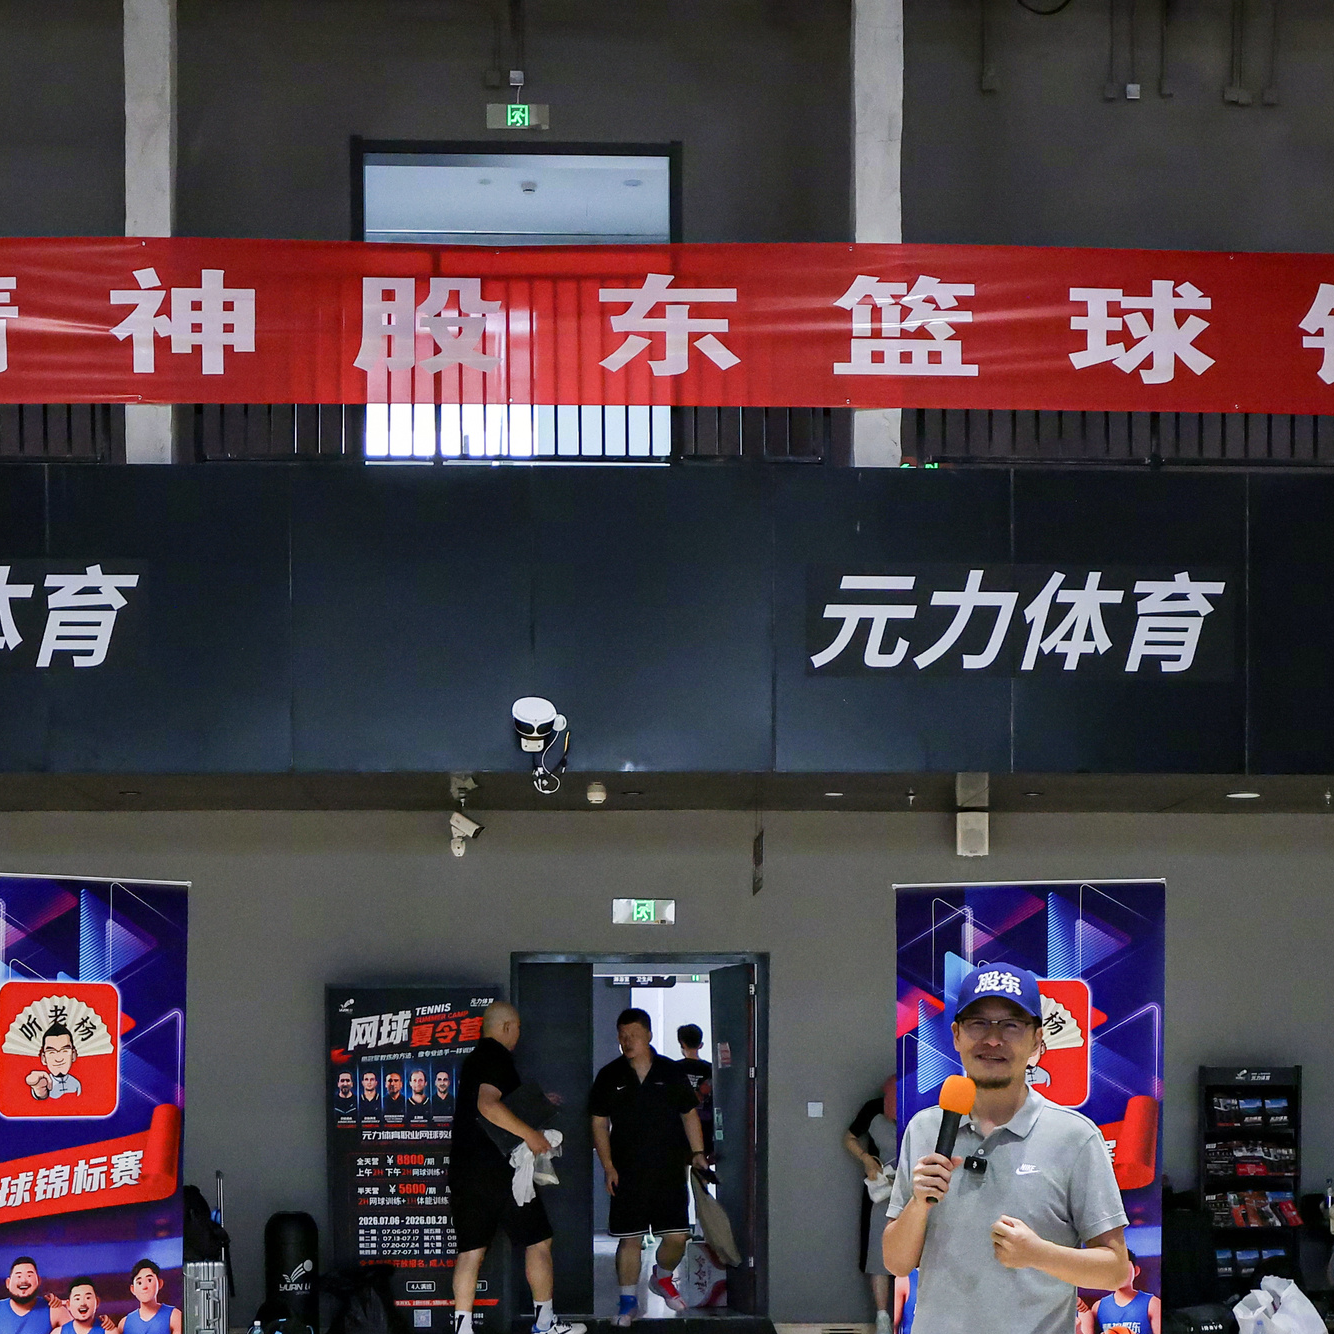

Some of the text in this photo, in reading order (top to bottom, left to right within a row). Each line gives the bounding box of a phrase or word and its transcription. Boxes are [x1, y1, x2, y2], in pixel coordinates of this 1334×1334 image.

[811, 569, 1225, 673] 元力体育
[974, 970, 1022, 996] 股东
[19, 1005, 97, 1041] 听老杨
[415, 1003, 452, 1016] TENNIS
[415, 1010, 470, 1024] SUMMER CAMP
[348, 1010, 412, 1051] 网球
[409, 1016, 484, 1048] 夏令营
[1020, 1163, 1037, 1171] NIKE
